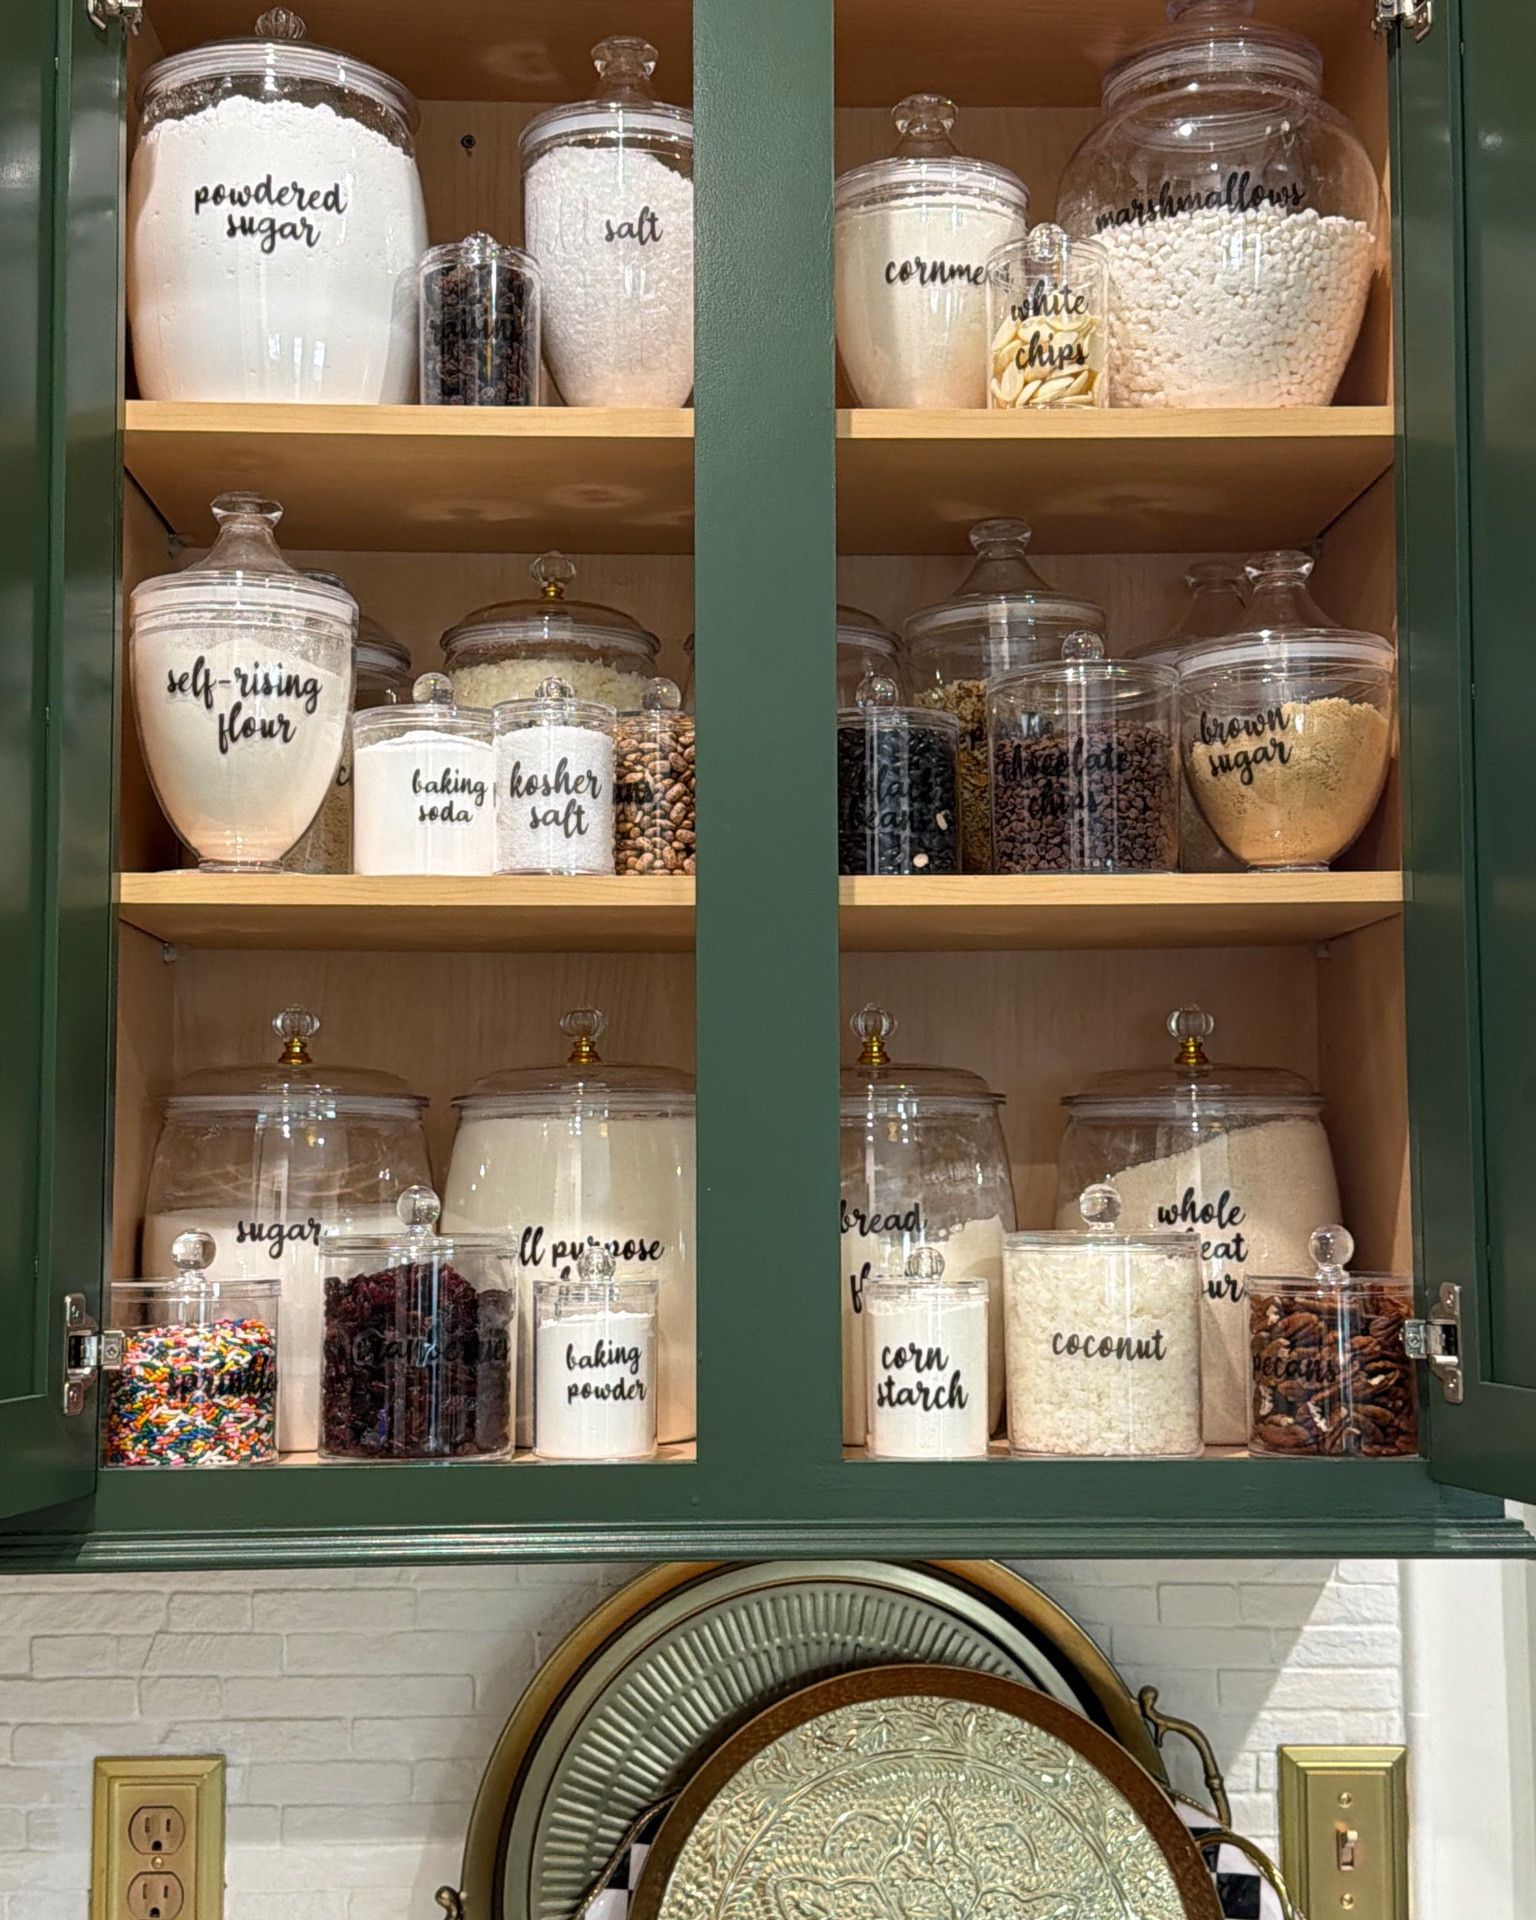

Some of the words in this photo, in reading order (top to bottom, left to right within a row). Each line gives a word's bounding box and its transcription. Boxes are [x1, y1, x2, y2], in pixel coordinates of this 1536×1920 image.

[195, 173, 348, 215] powdered
[1096, 170, 1305, 232] marshmallows
[226, 213, 321, 254] sugar
[604, 205, 664, 246] salt
[885, 256, 988, 285] cornme
[1010, 279, 1090, 322] white
[1014, 330, 1089, 371] chips
[167, 655, 323, 714] self-rising
[218, 701, 297, 754] flour
[1200, 706, 1291, 745] brown
[509, 756, 602, 800] kosher
[1209, 737, 1293, 785] sugar
[411, 767, 488, 805] baking
[418, 800, 473, 823] soda
[529, 798, 589, 838] salt
[840, 1200, 928, 1237] bread
[1157, 1186, 1246, 1230] whole
[236, 1217, 322, 1260] sugar
[519, 1226, 546, 1266] ll
[1200, 1232, 1248, 1263] eat
[566, 1338, 643, 1375] baking
[881, 1342, 949, 1373] corn
[1051, 1328, 1168, 1361] coconut
[1252, 1351, 1338, 1383] pecans
[567, 1376, 648, 1405] powder
[876, 1369, 969, 1412] starch
